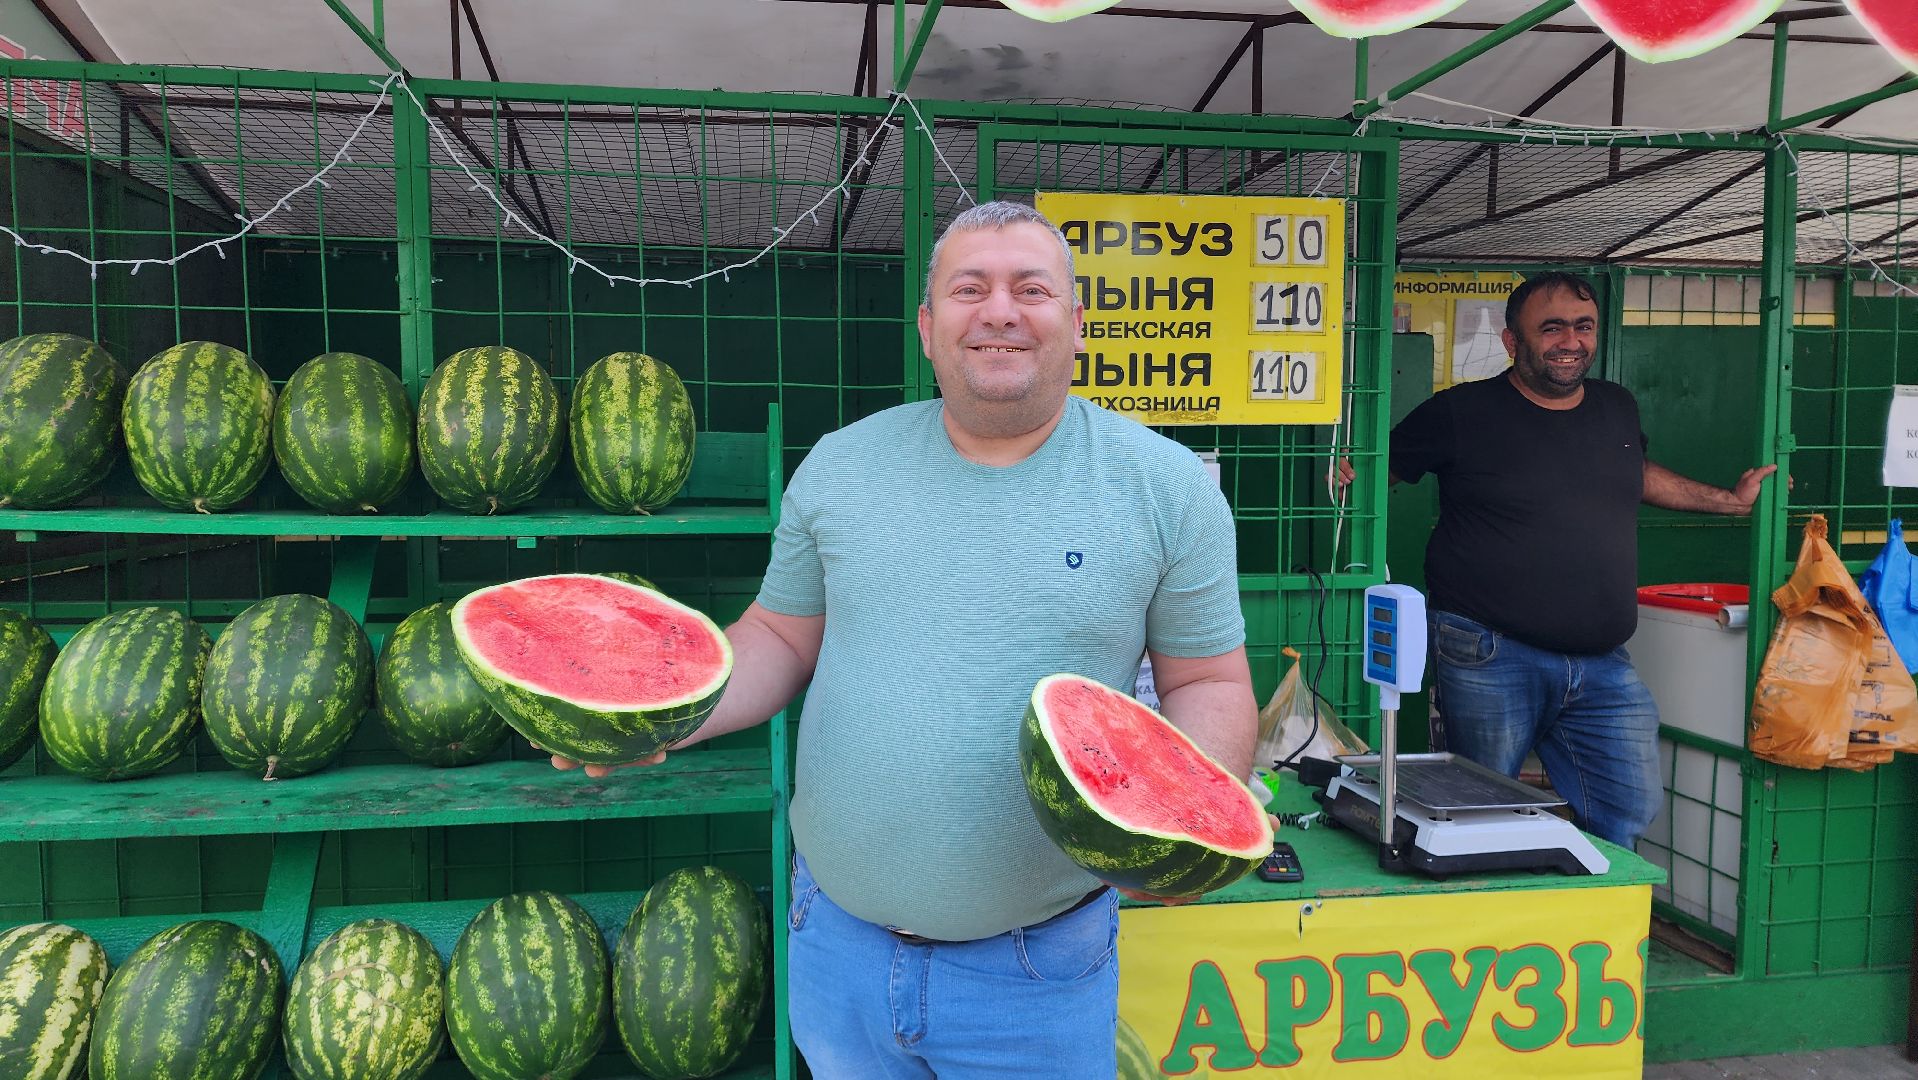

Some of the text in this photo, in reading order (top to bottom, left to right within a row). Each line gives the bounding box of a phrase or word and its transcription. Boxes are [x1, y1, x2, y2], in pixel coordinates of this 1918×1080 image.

[1060, 220, 1233, 257] АРБУЗ
[1262, 217, 1323, 261] 50
[1256, 284, 1322, 326] 110
[1394, 281, 1513, 294] ИНФОРМАЦИЯ
[1253, 355, 1308, 395] 110
